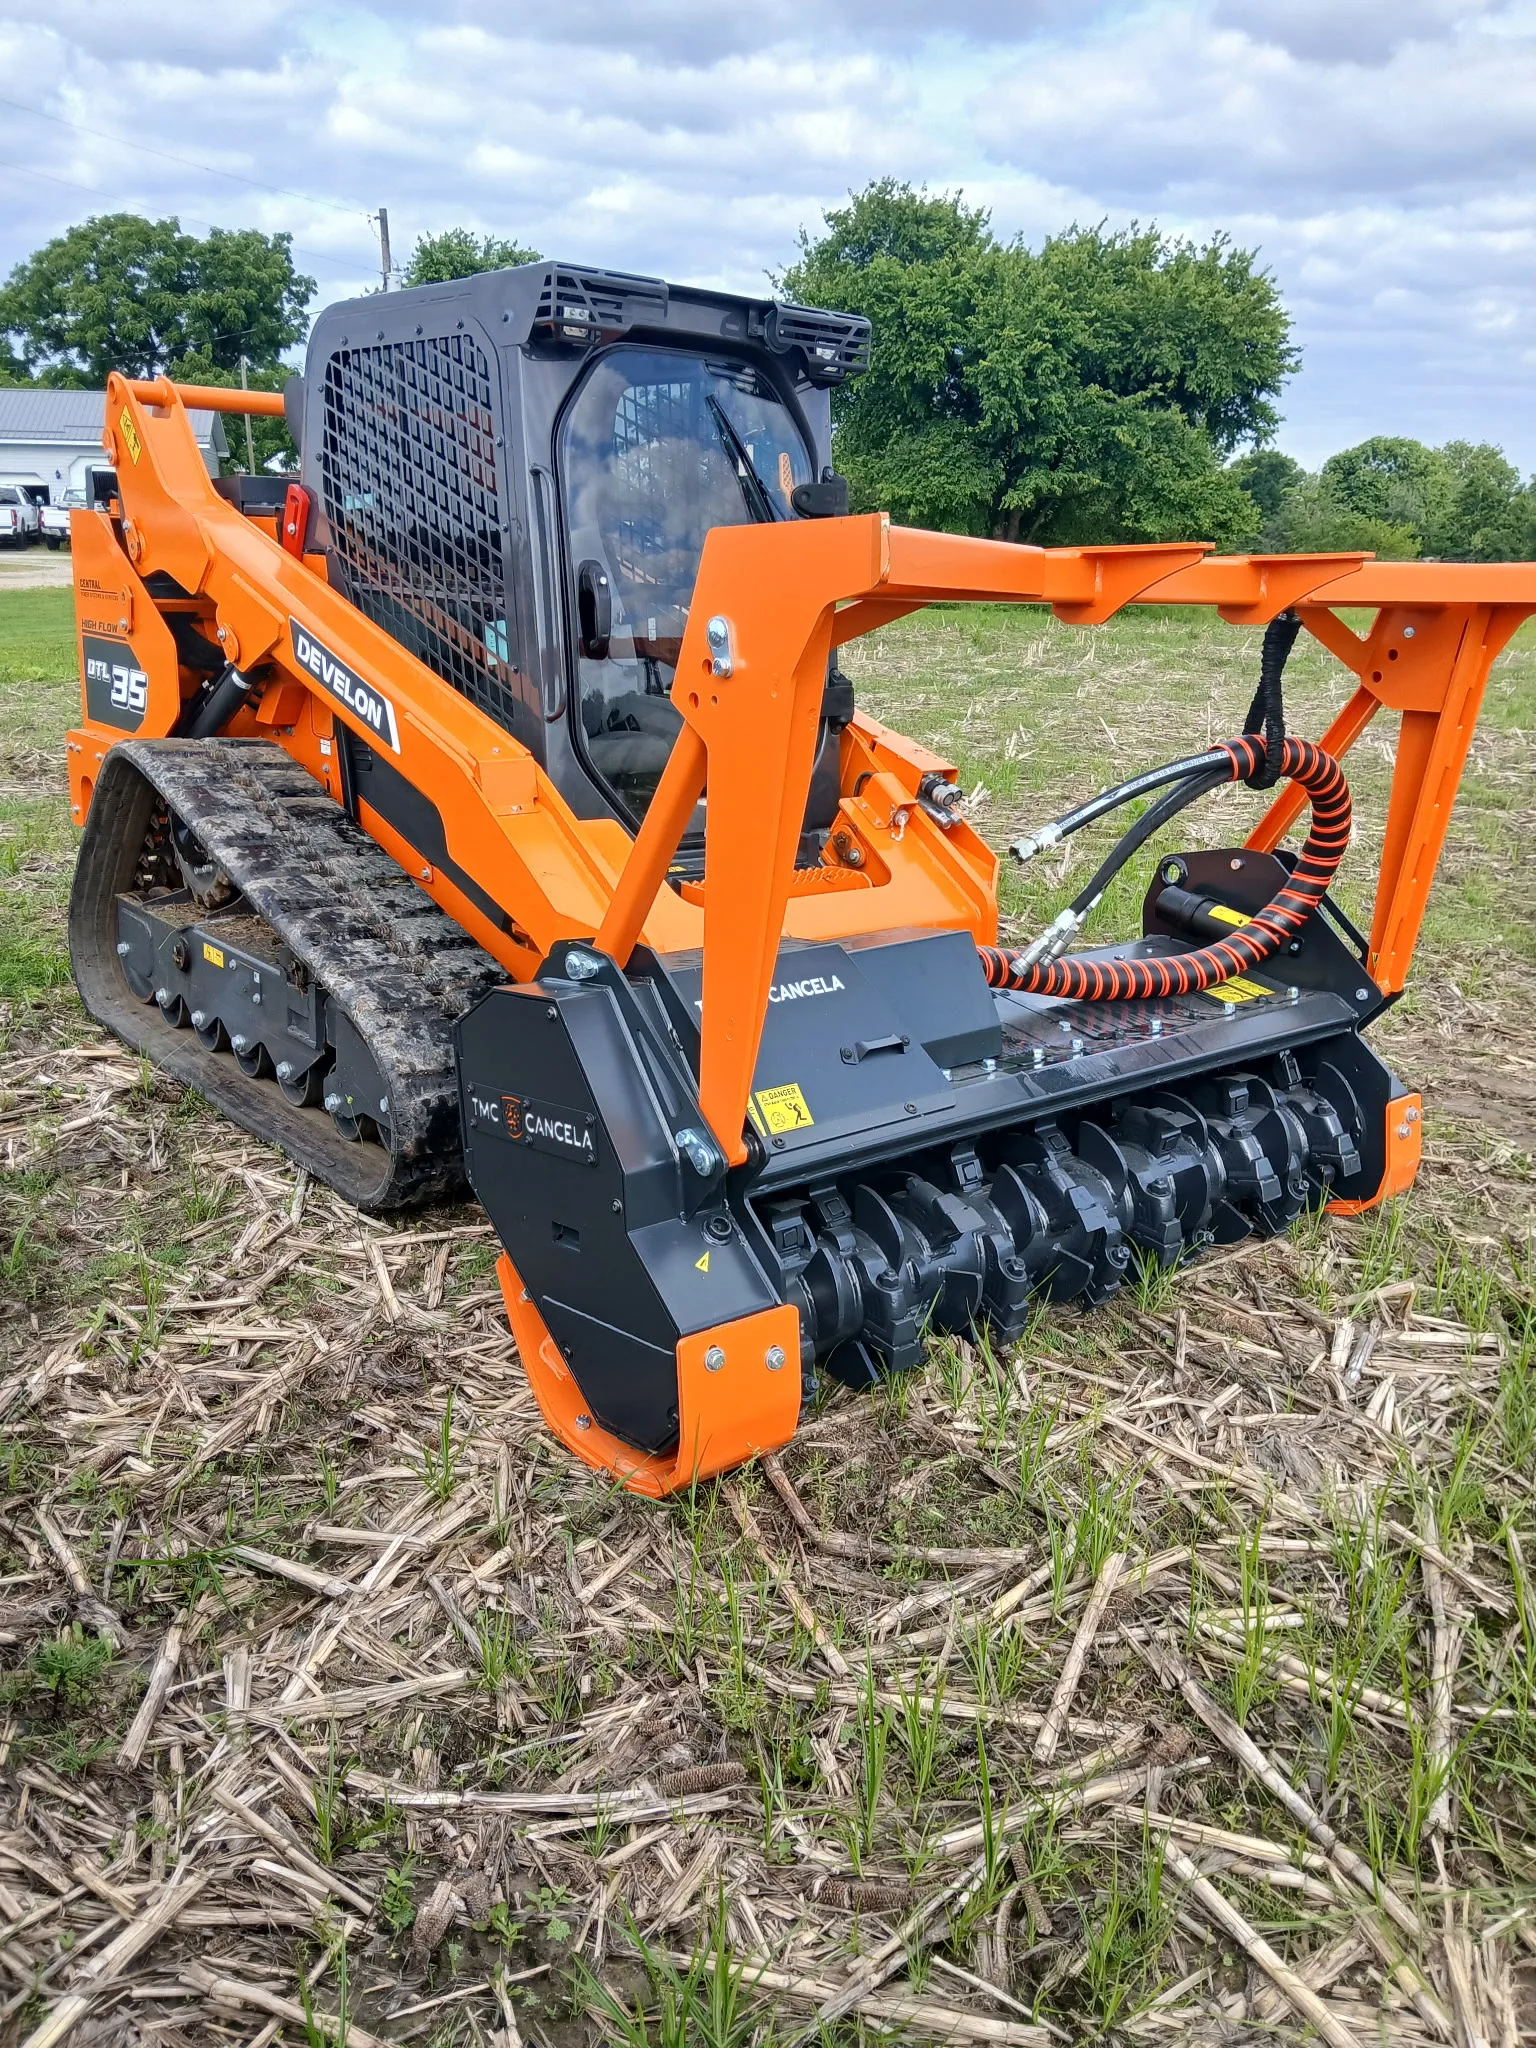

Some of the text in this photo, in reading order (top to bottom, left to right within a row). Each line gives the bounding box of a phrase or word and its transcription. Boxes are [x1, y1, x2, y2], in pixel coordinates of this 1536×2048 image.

[80, 579, 101, 589] CENTRAL
[81, 619, 118, 633] HIGH FLOW
[87, 658, 148, 715] DTL 35
[297, 634, 382, 729] DEVELON
[768, 975, 845, 1003] CANCELA
[768, 1087, 797, 1100] DANGER
[472, 1097, 593, 1150] TMC CANCELA
